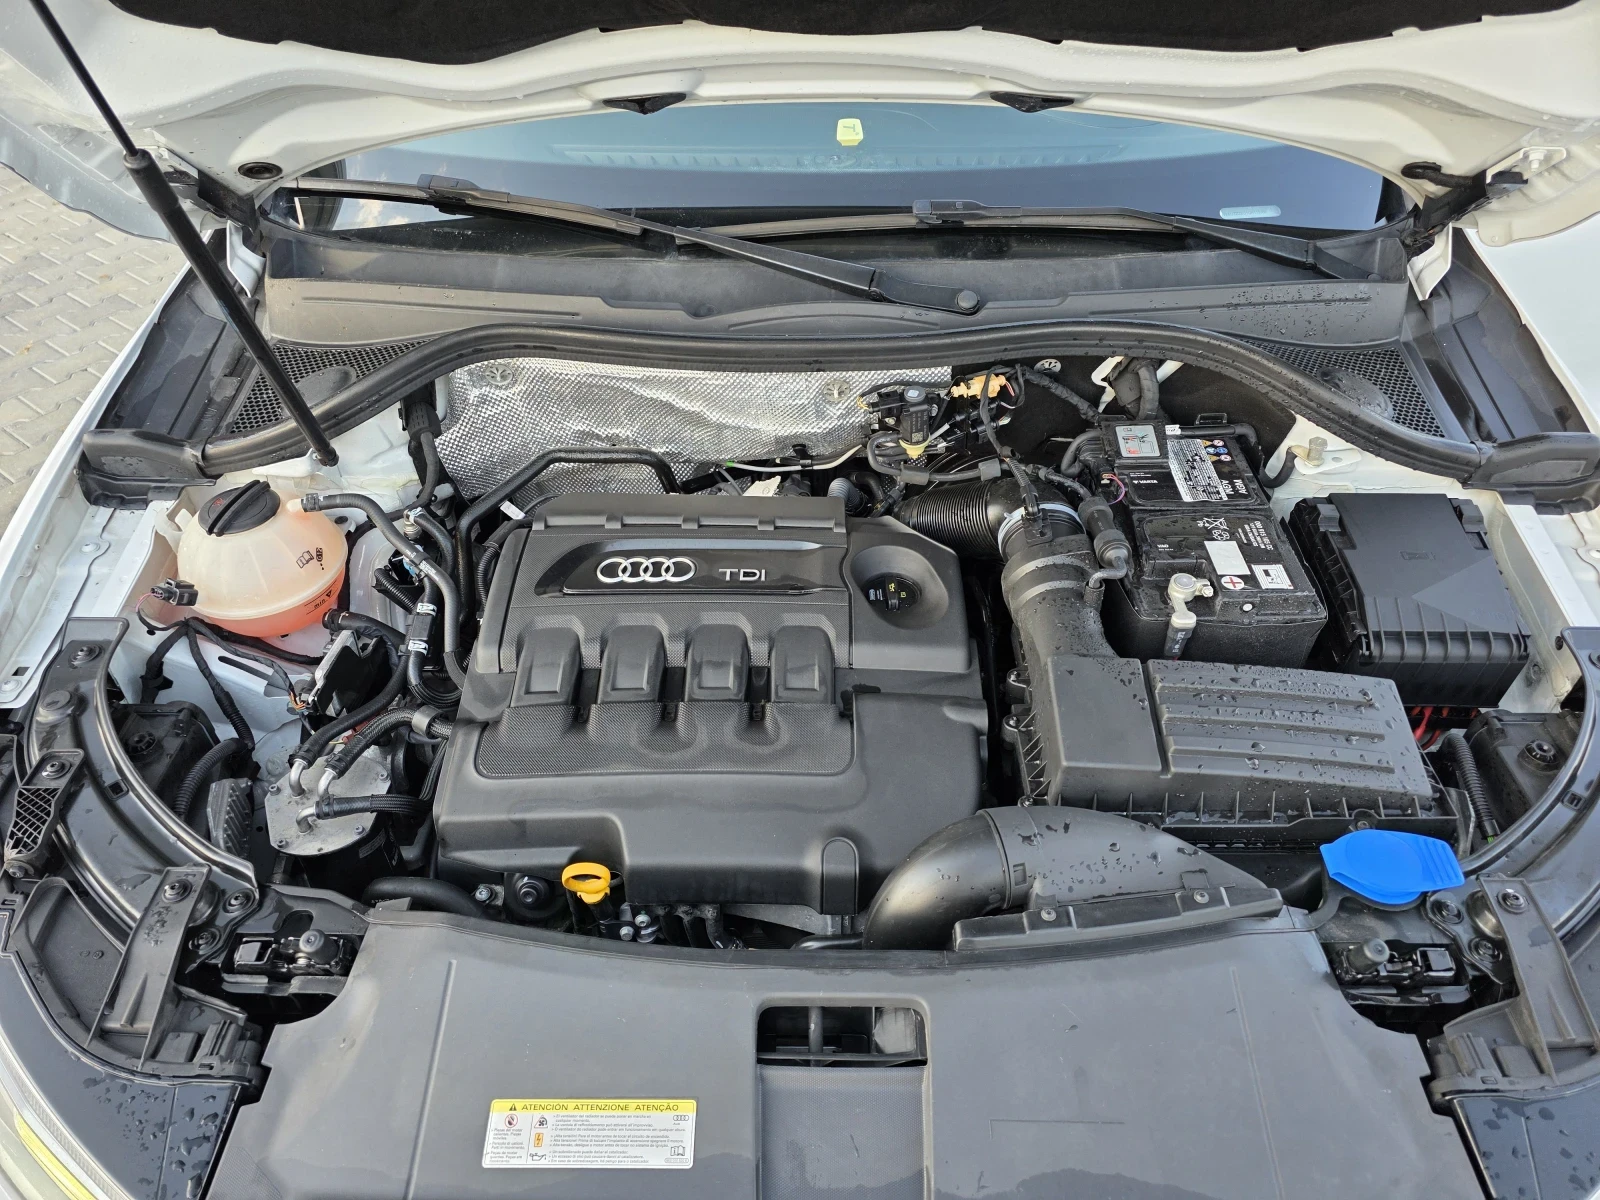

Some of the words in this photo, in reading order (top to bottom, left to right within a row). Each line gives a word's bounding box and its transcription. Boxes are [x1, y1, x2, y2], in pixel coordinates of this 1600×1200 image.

[1221, 480, 1234, 494] AGM
[1233, 479, 1248, 494] AGM
[718, 568, 766, 581] TDI
[634, 1102, 679, 1112] ATENÇÃO
